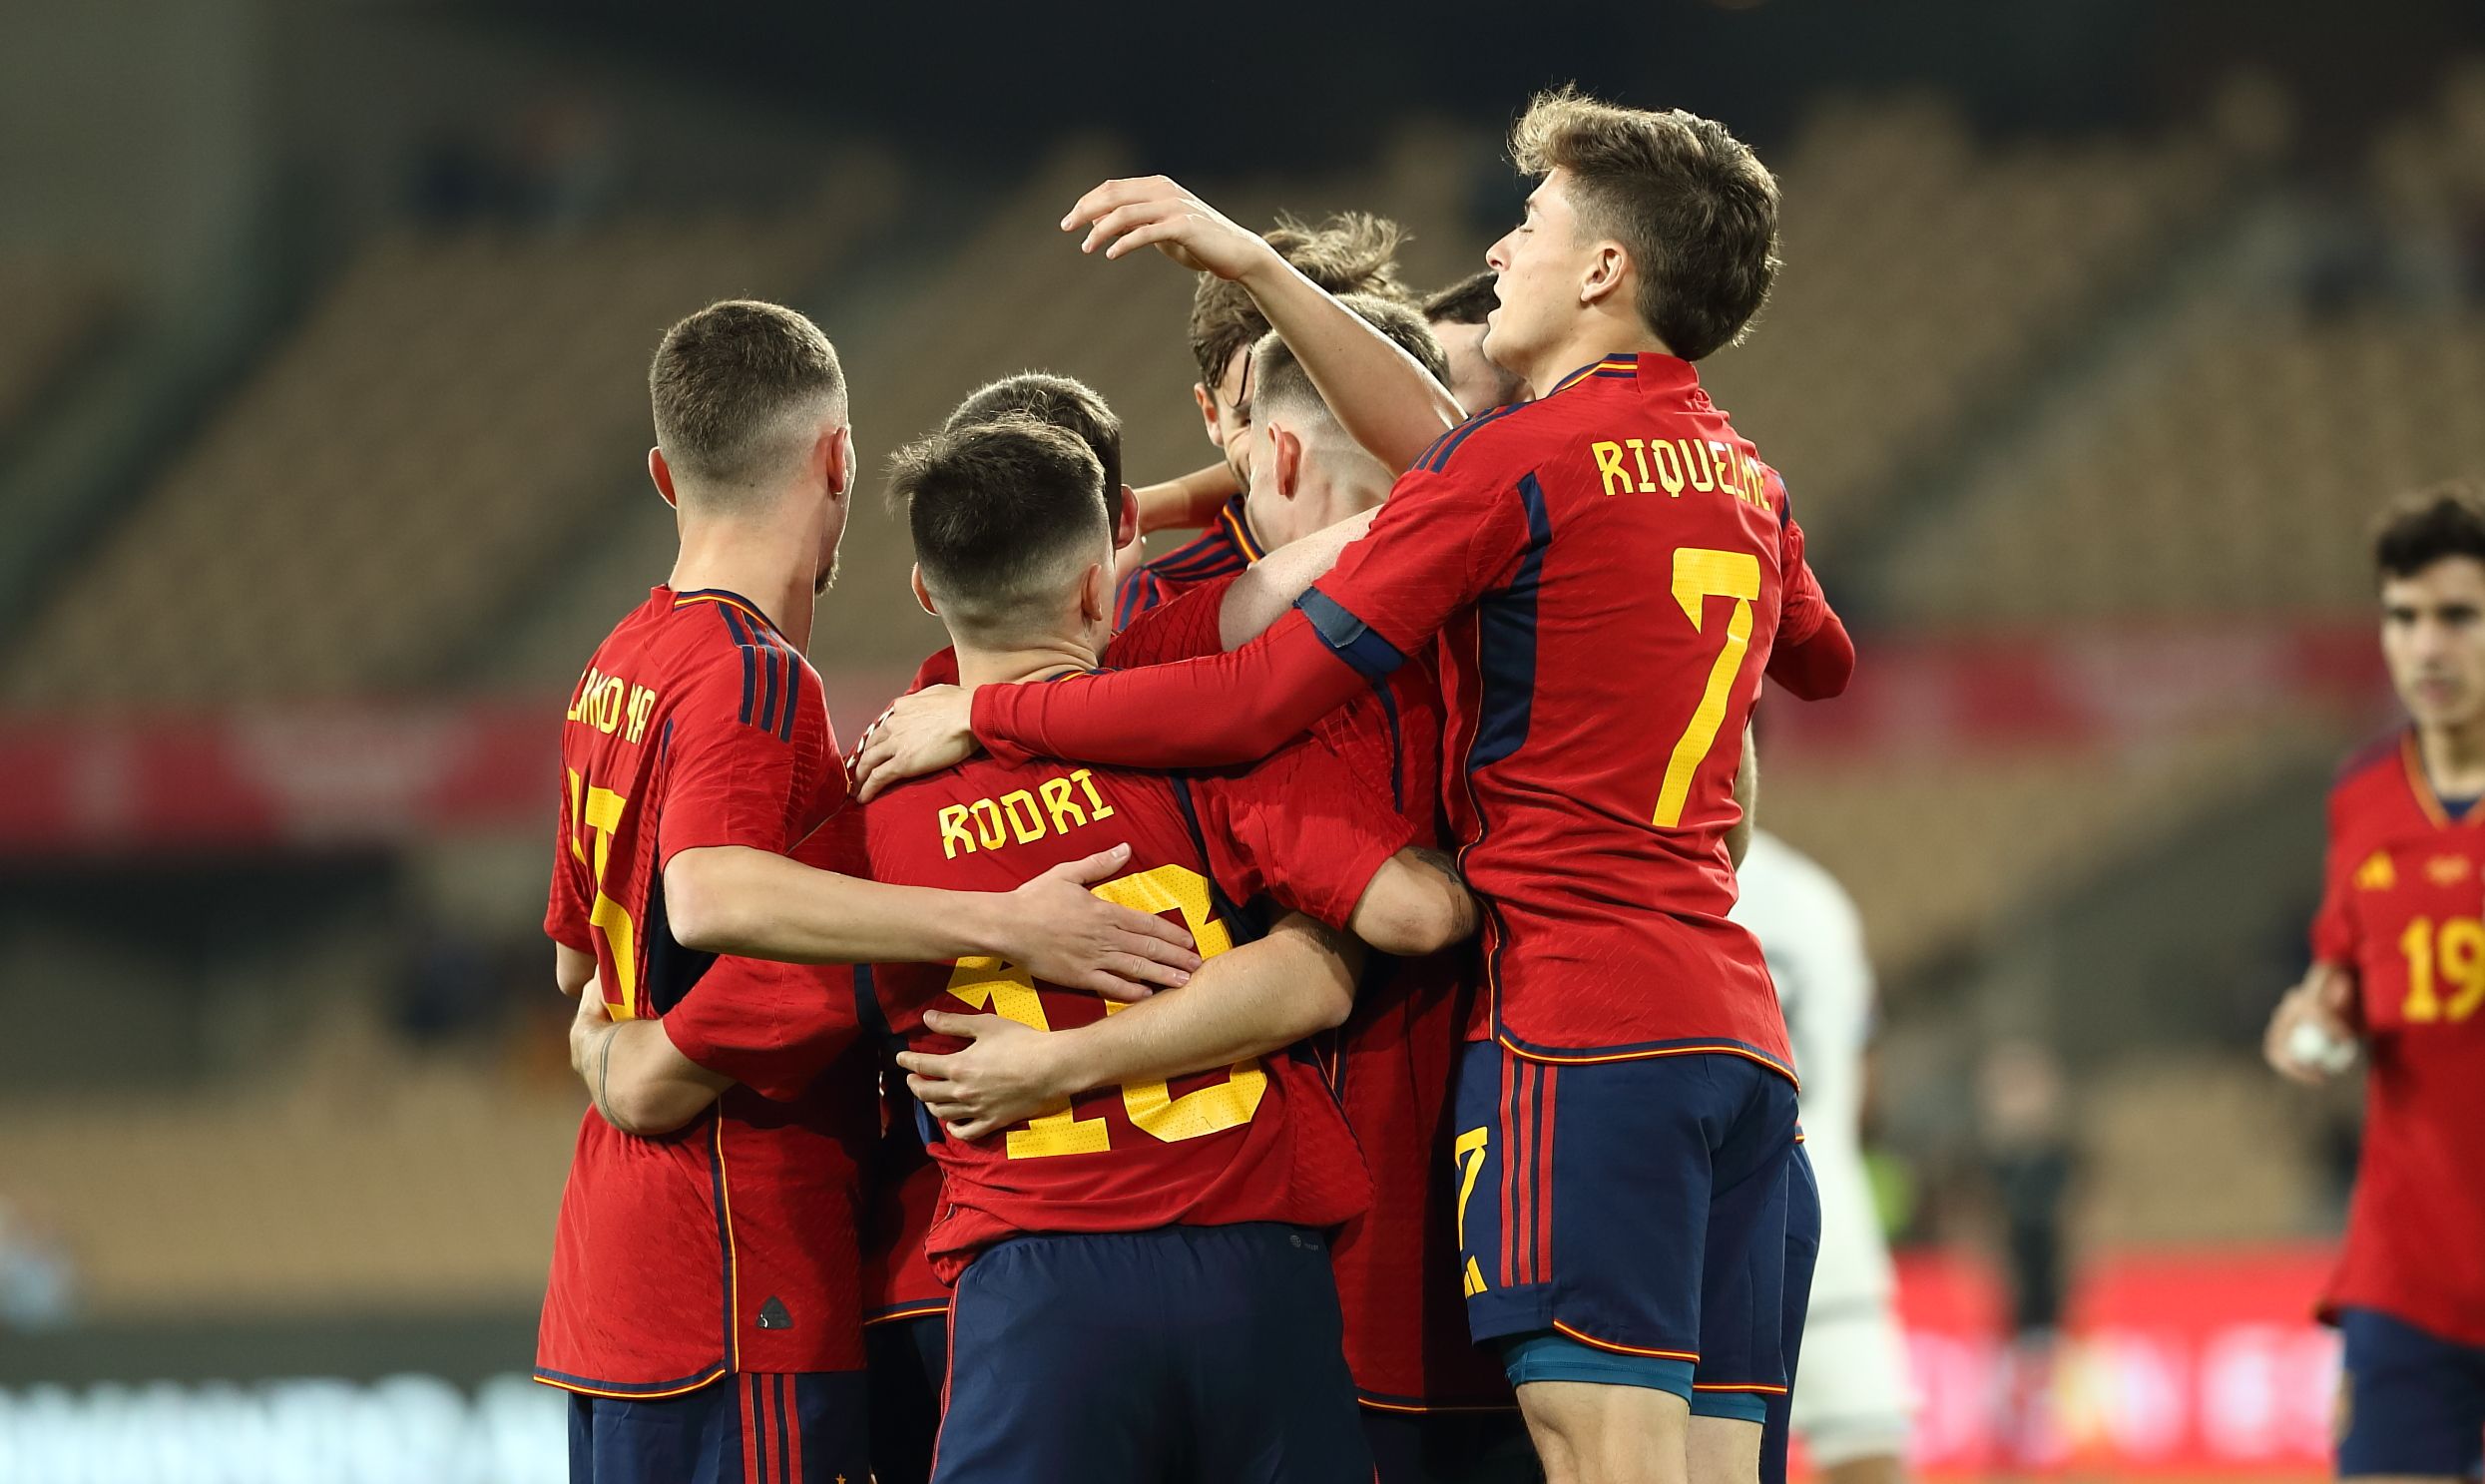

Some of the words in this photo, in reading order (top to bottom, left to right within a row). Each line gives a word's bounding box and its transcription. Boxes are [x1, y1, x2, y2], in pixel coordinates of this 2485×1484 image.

[1592, 438, 1771, 512] RIQUELME
[1652, 546, 1761, 828] 7
[937, 767, 1116, 860] RODRI
[2399, 915, 2485, 1023] 19
[1454, 1125, 1489, 1252] 7
